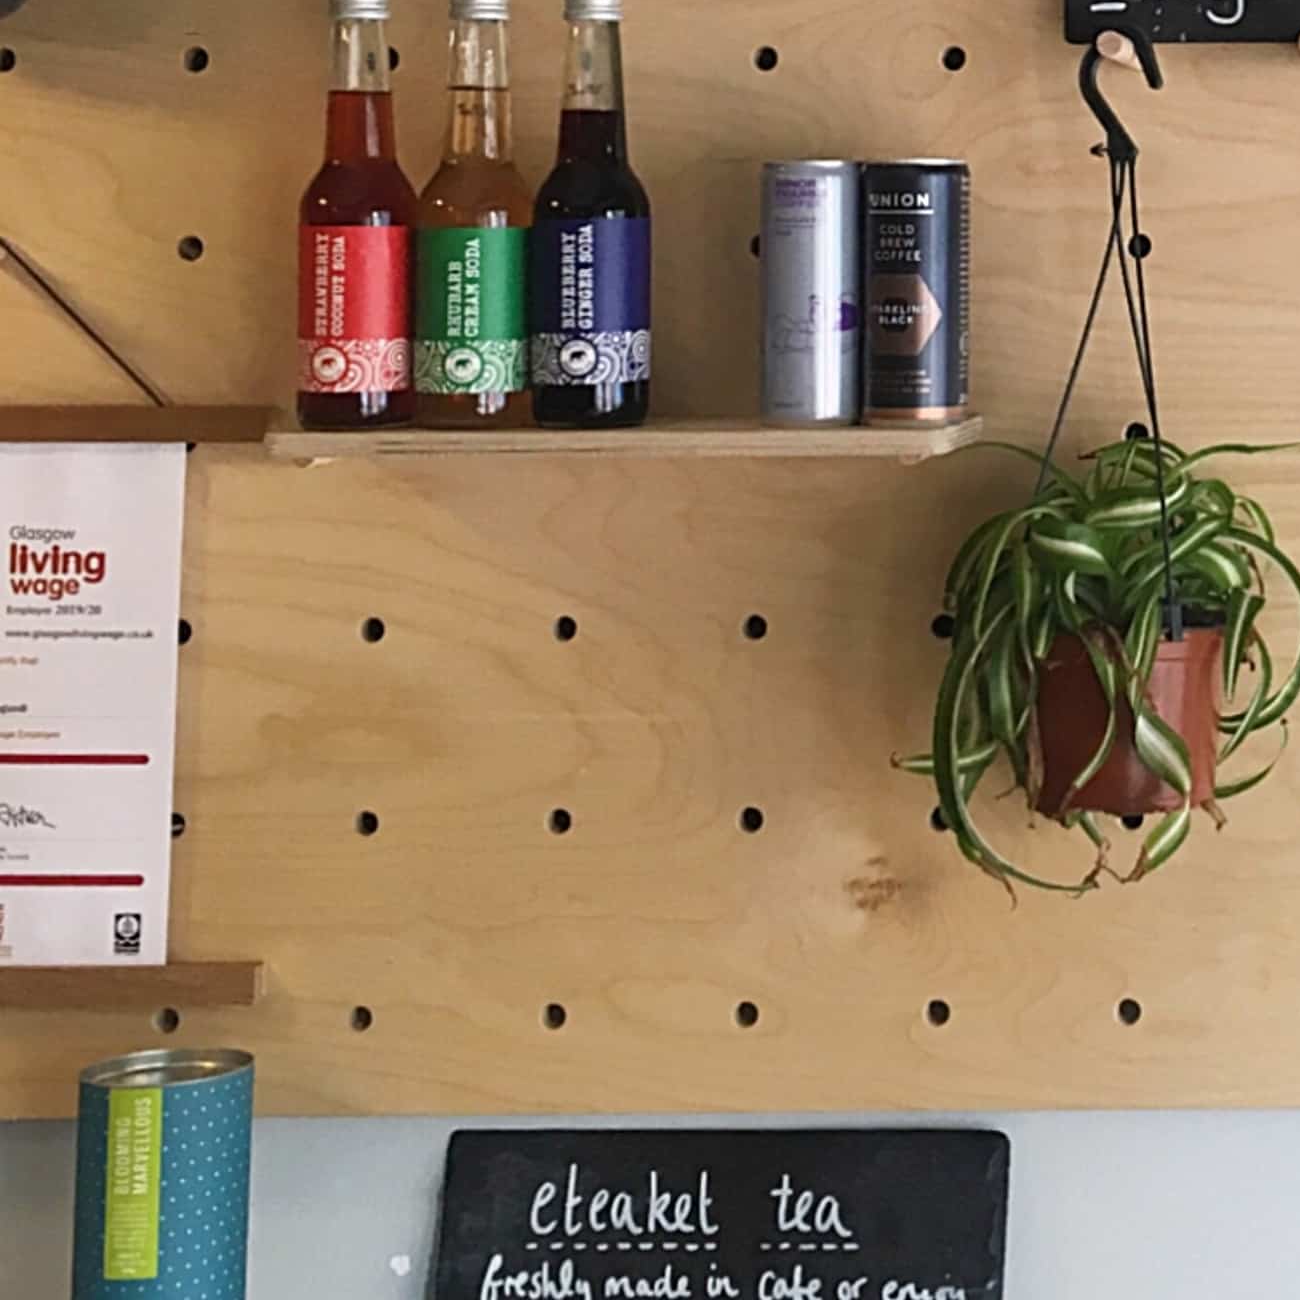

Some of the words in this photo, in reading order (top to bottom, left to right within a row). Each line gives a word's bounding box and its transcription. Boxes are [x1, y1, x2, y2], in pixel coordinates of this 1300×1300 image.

[868, 193, 929, 207] UNION
[578, 223, 593, 263] SODA
[879, 224, 915, 236] COLD
[880, 237, 915, 248] BREW
[332, 235, 345, 271] SODA
[465, 238, 480, 277] SODA
[874, 249, 921, 262] COFFEE
[315, 233, 329, 336] STRAWBERRY
[447, 260, 462, 337] RHUBARB
[561, 232, 576, 329] BLUEBERRY
[578, 265, 593, 329] GINGER
[464, 281, 480, 337] CREAM
[9, 525, 76, 543] Glasgow
[9, 543, 106, 584] living
[10, 578, 80, 601] wage
[113, 1117, 132, 1195] BLOOMING
[132, 1097, 152, 1195] MARVELLOUS
[528, 1163, 719, 1237] eteaket
[770, 1174, 853, 1238] tea
[604, 1264, 692, 1298] made
[706, 1261, 739, 1297] in
[837, 1275, 868, 1299] or
